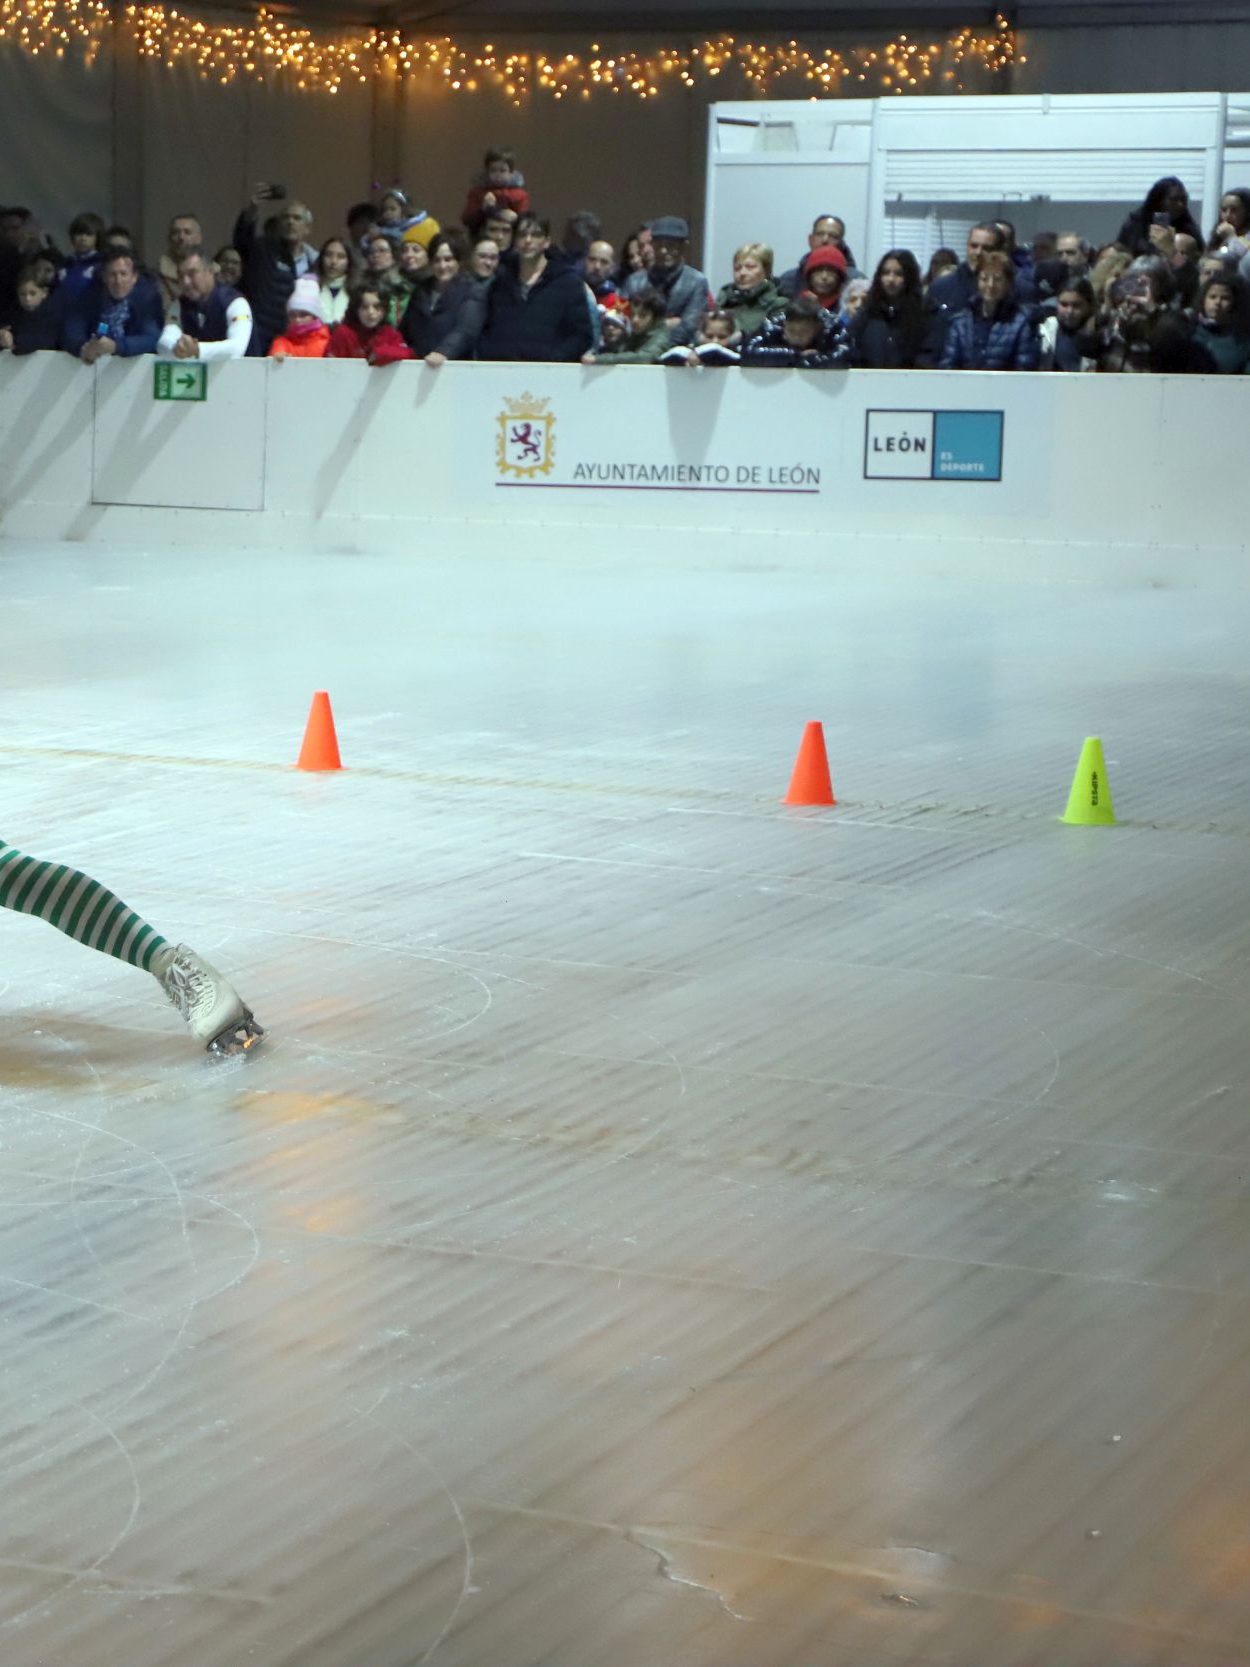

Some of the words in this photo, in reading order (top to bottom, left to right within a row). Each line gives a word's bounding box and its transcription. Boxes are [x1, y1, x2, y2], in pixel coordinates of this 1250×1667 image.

[873, 431, 927, 453] LEÓN
[573, 463, 730, 483] AYUNTAMIENTO
[736, 466, 761, 483] DE
[768, 463, 821, 484] LEÓN
[940, 462, 985, 473] DEPORTE
